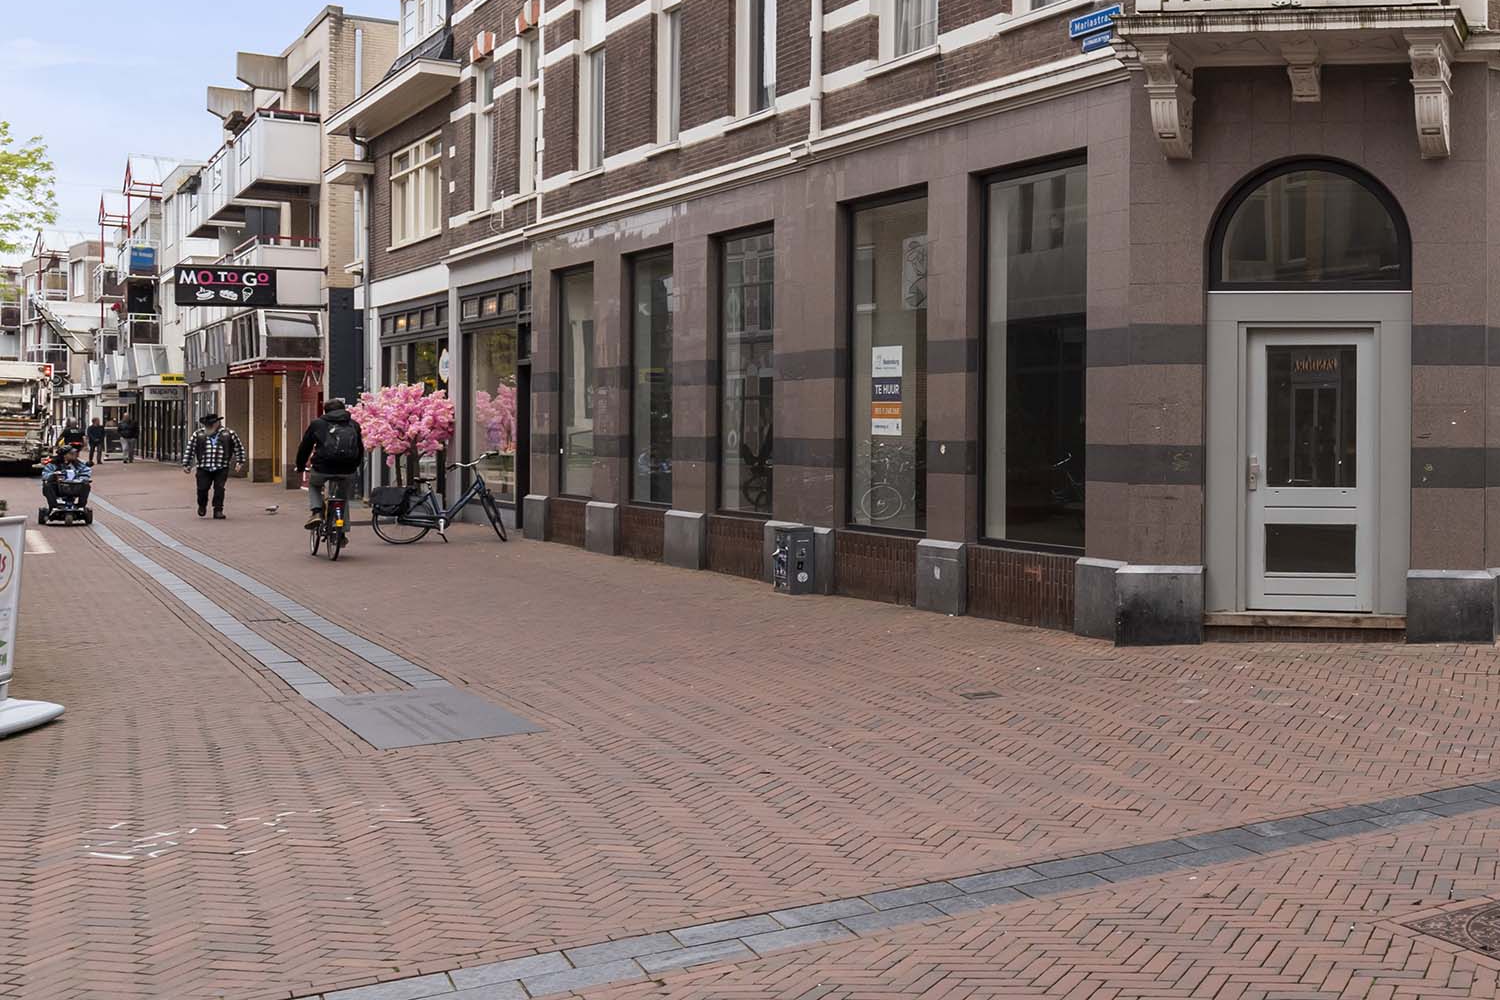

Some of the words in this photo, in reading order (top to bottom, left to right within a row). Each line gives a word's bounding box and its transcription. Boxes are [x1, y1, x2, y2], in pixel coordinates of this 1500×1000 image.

[179, 270, 214, 285] MO
[874, 384, 882, 395] TE
[883, 384, 900, 395] HUUR
